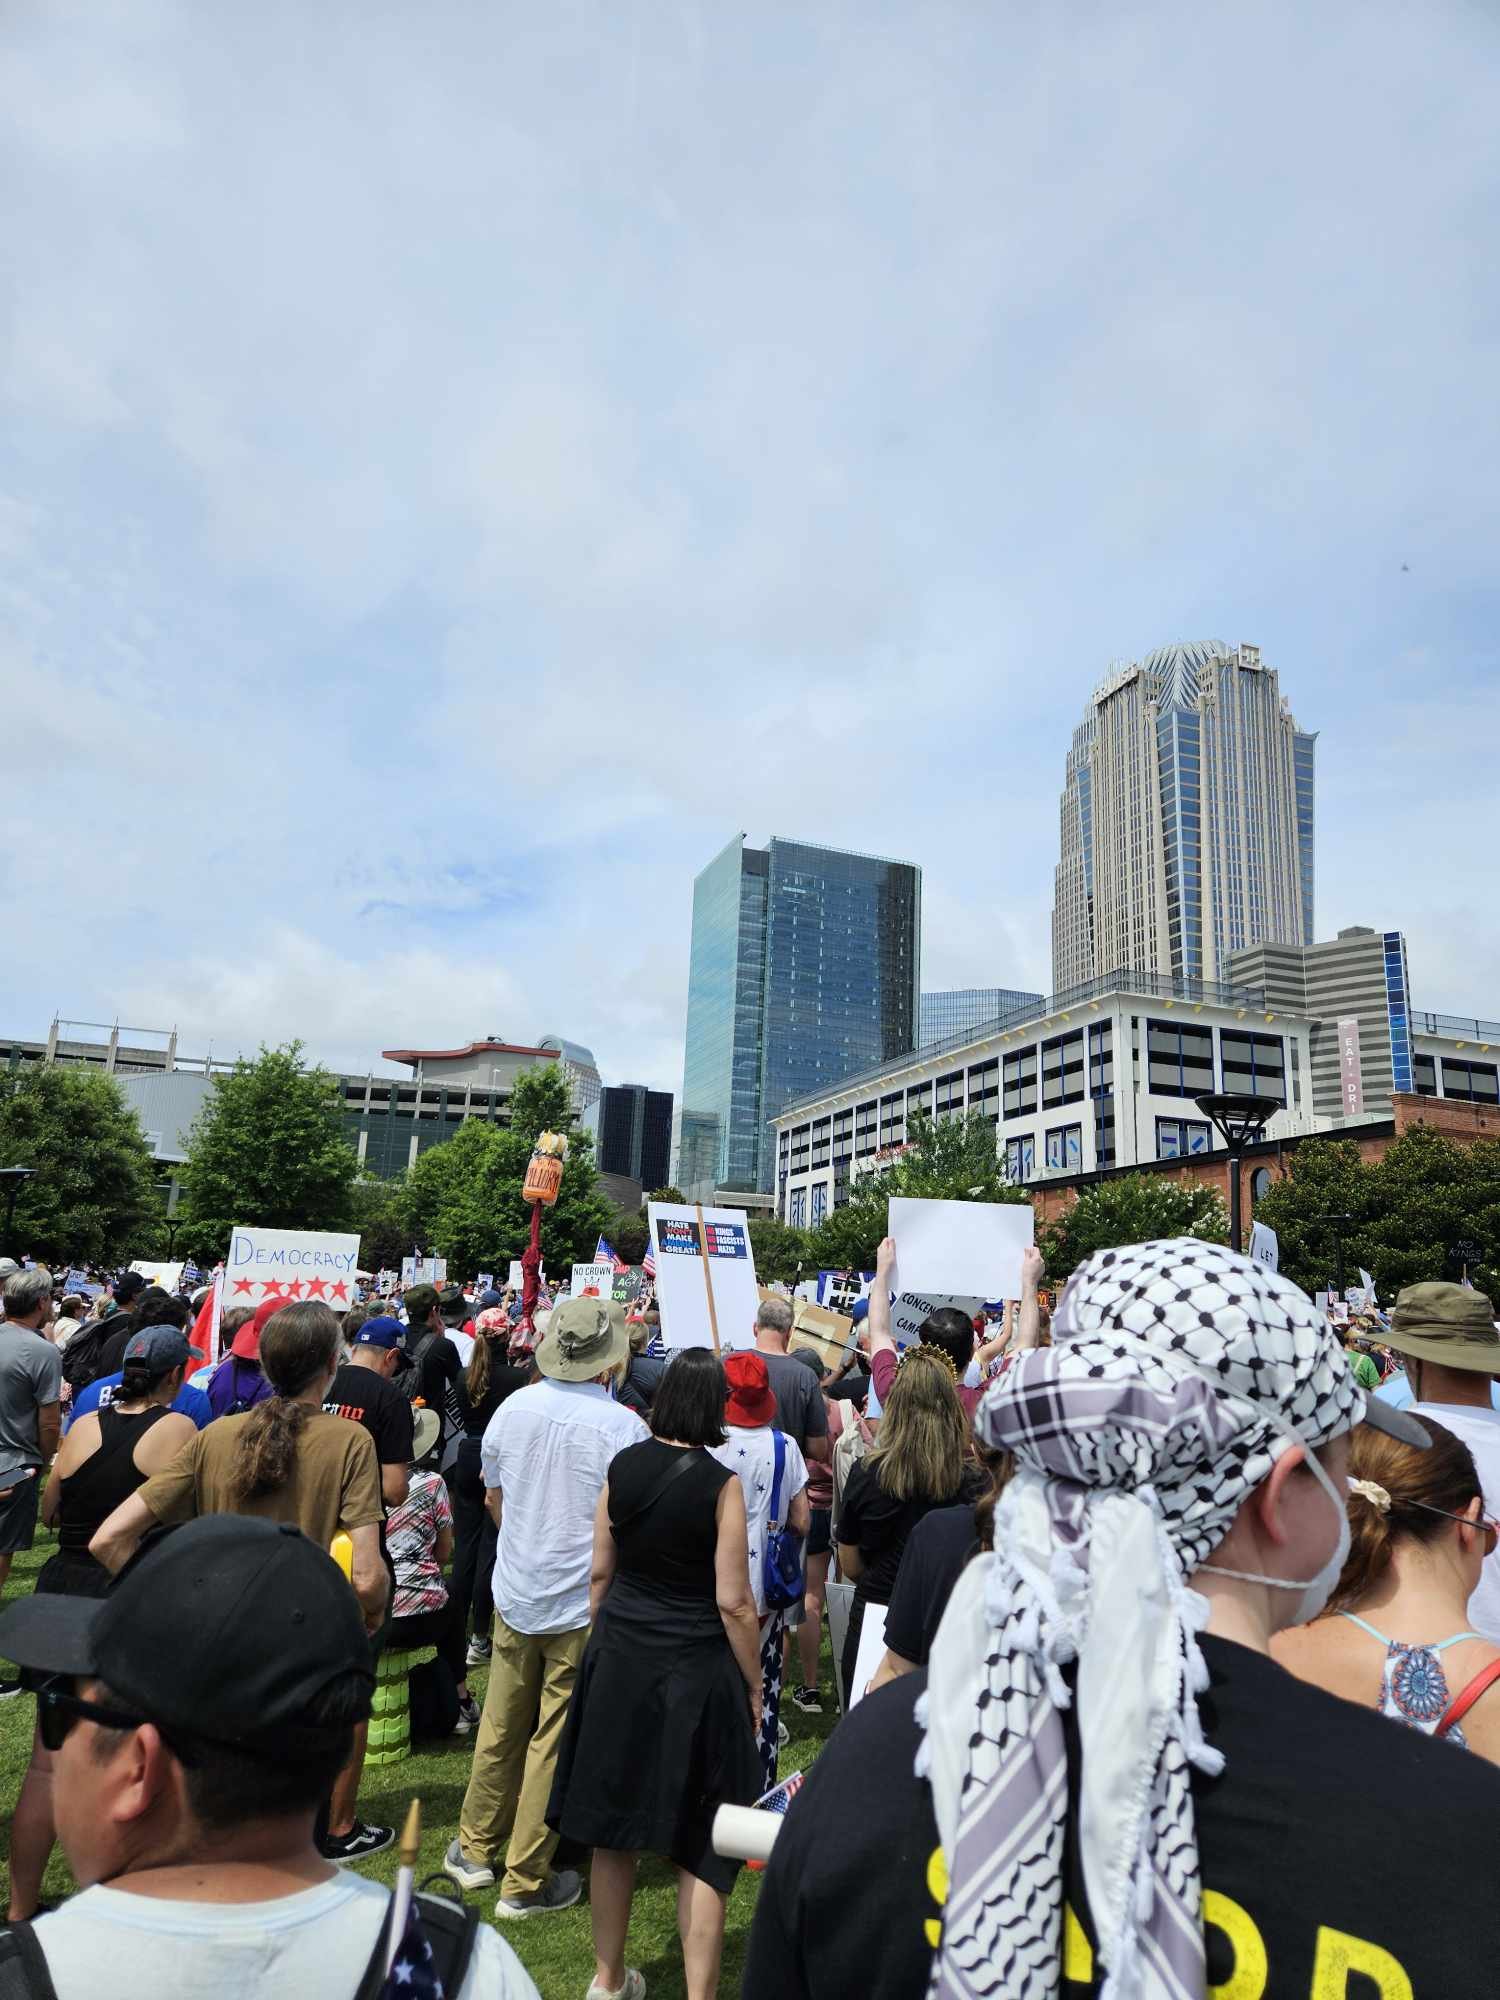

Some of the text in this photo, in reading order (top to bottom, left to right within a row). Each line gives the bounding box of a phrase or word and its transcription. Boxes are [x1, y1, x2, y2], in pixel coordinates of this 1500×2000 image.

[1345, 1037, 1356, 1113] EAT DRI
[667, 1220, 689, 1229] HATE
[706, 1226, 735, 1237] NO KINGS
[667, 1233, 693, 1242] MAKE
[717, 1236, 744, 1246] FASCISTS
[708, 1244, 736, 1254] NO NAZIS
[573, 1266, 611, 1277] NO CROWN
